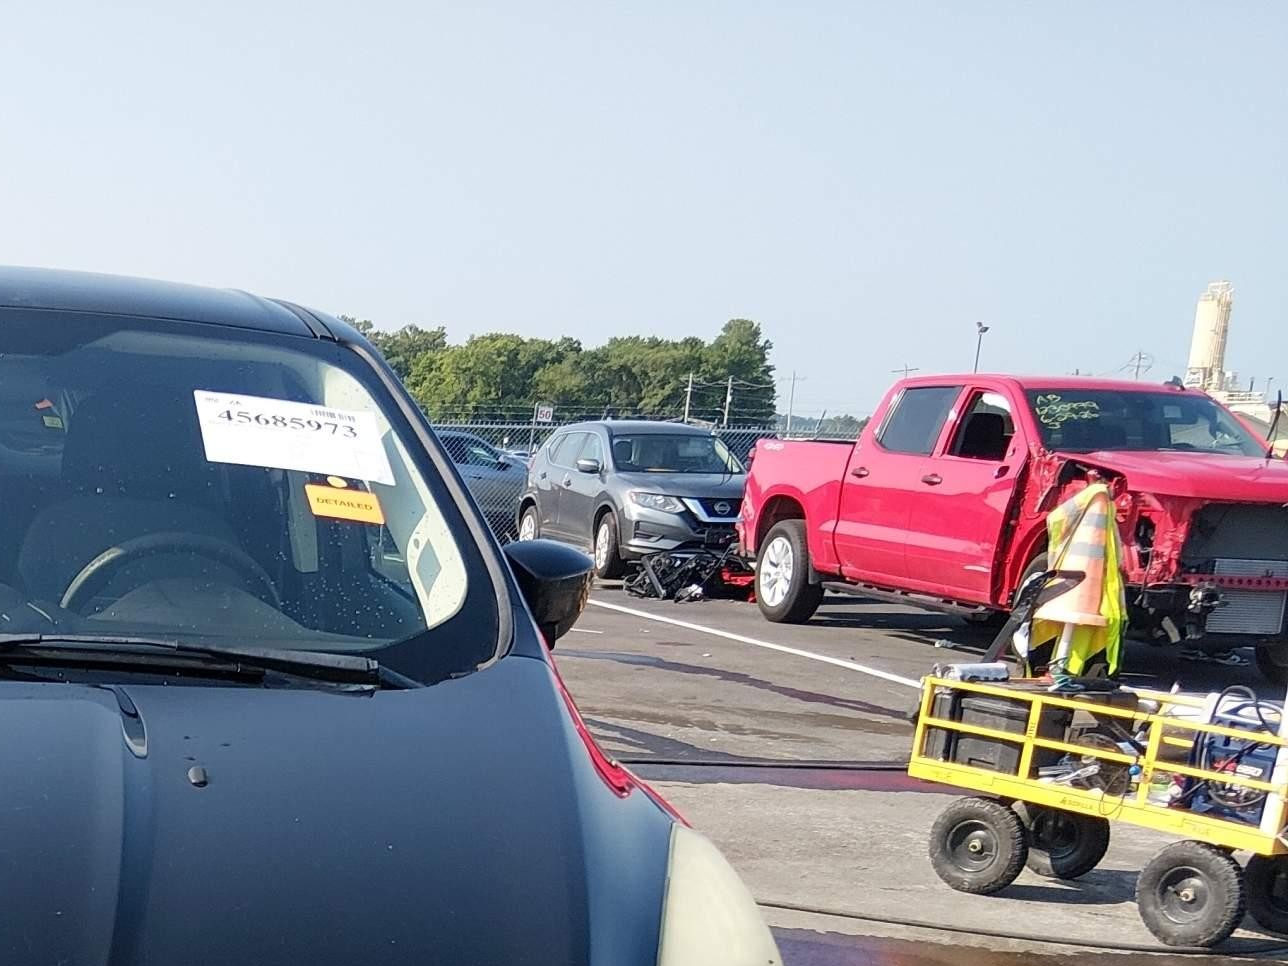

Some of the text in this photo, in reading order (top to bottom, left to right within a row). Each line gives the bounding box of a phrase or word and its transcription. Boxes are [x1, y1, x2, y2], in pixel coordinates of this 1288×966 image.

[539, 409, 551, 420] 50
[217, 409, 358, 439] 45685973
[316, 496, 374, 511] DETAILED
